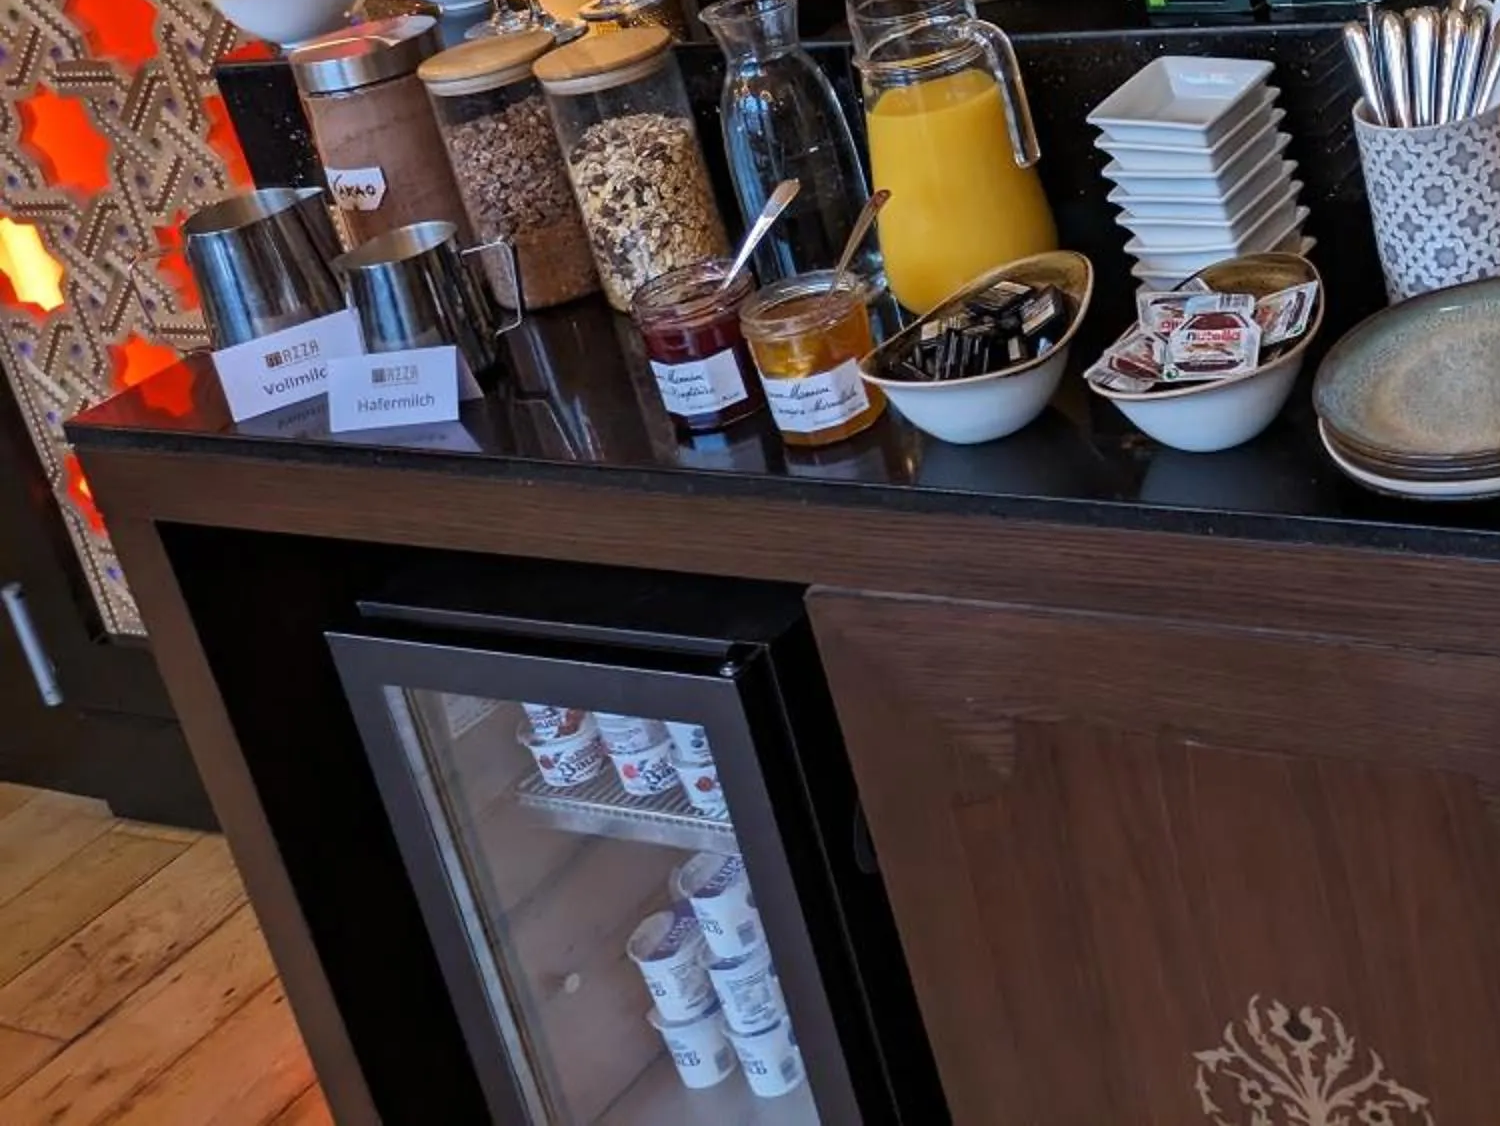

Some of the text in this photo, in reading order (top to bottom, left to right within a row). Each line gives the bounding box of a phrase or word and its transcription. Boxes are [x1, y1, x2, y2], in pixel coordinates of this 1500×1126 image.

[1186, 329, 1241, 342] nutella
[262, 366, 329, 396] Vollmilc
[357, 392, 436, 413] Hafermilch
